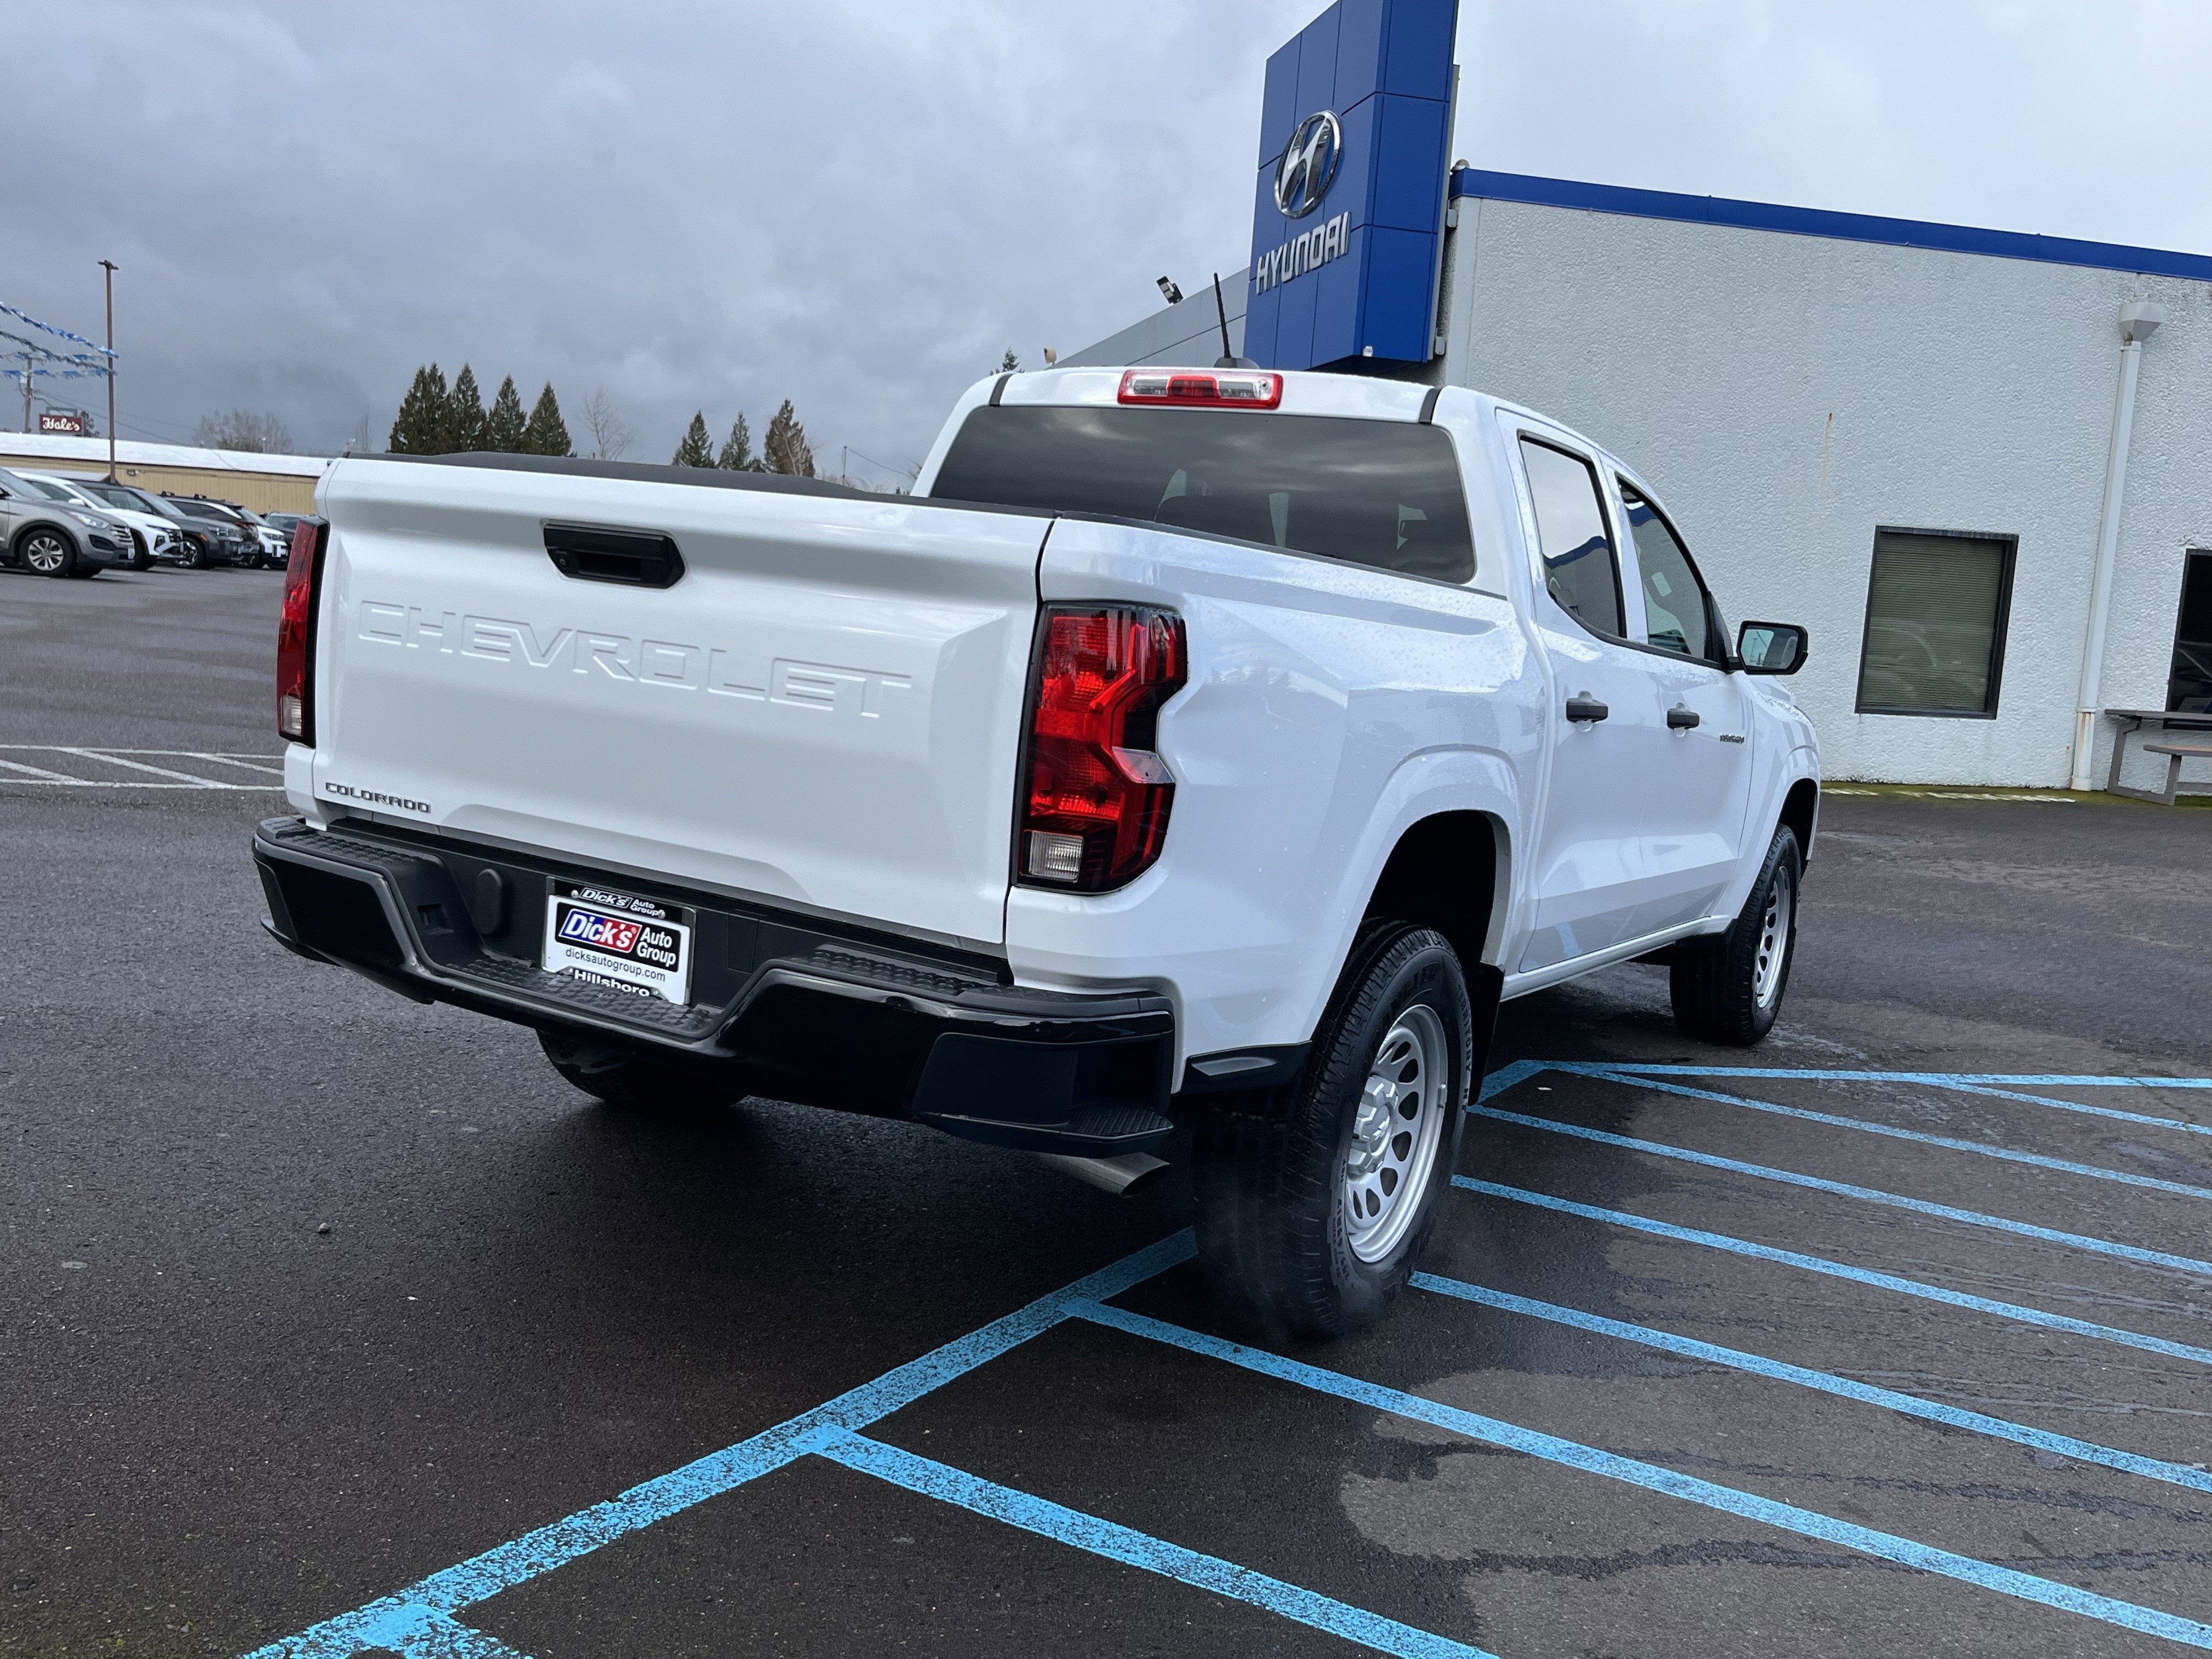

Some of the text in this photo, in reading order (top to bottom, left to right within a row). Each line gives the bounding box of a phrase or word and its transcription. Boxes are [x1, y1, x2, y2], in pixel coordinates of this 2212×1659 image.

[1256, 211, 1351, 295] HYUNDAI
[42, 416, 81, 432] Hale's
[358, 599, 912, 718] CHEVROLET
[325, 781, 432, 813] COLORADO
[582, 889, 628, 906] Dick's
[630, 905, 659, 917] Group
[633, 899, 655, 909] Auto
[564, 913, 634, 949] Dick's
[640, 927, 673, 948] Auto
[565, 947, 666, 982] dicksautogroup.com
[636, 941, 677, 968] Group
[574, 969, 651, 997] Hillsboro
